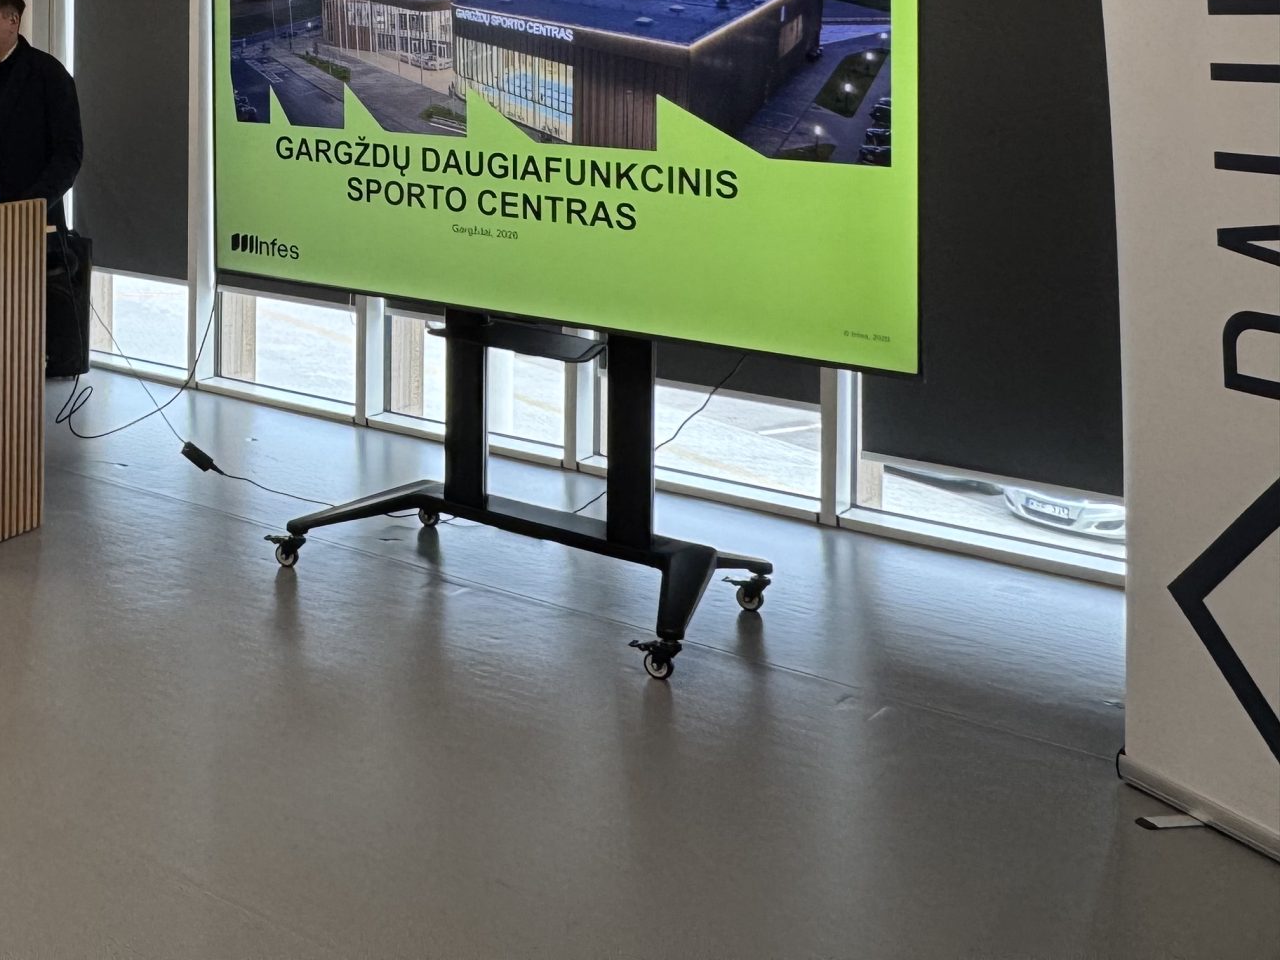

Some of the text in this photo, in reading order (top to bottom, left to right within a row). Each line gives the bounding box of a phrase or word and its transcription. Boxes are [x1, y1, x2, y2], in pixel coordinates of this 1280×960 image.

[490, 14, 526, 32] SPORTO
[526, 21, 574, 42] CENTRAS
[276, 136, 739, 200] GARGŽDŲ DAUGIAFUNKCINIS
[347, 176, 638, 231] SPORTO CENTRAS
[255, 235, 300, 260] Infes
